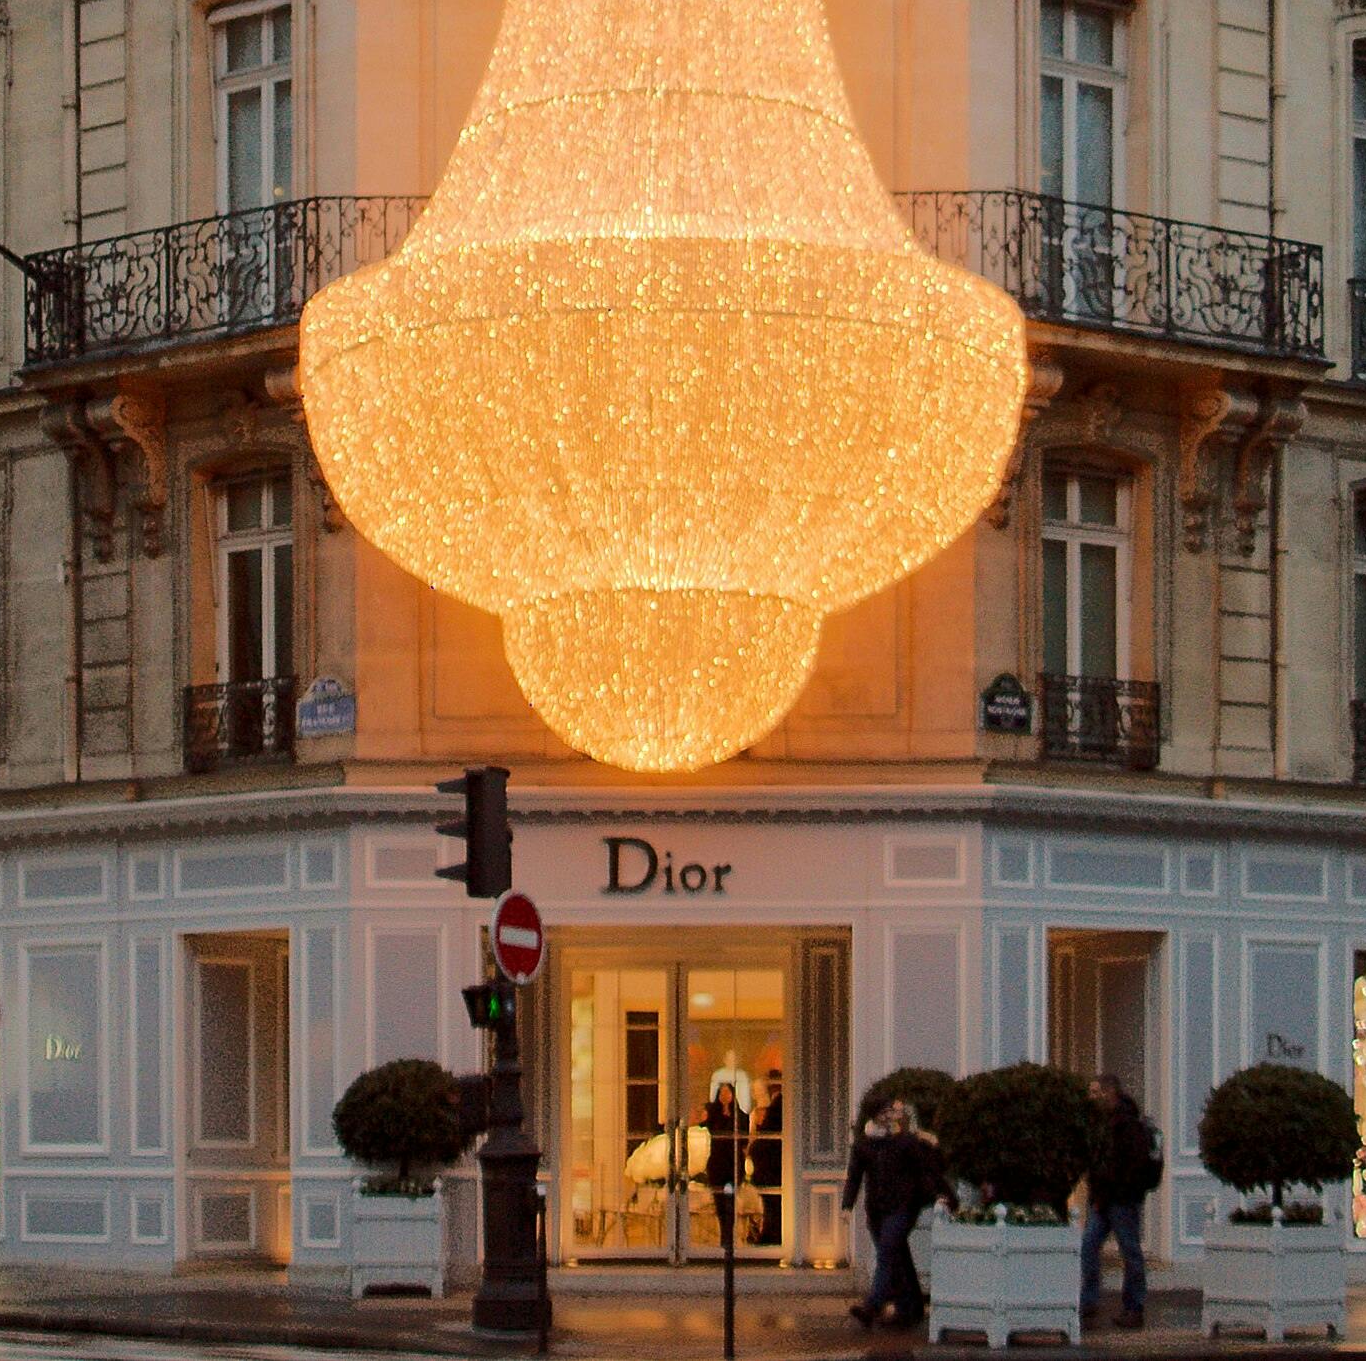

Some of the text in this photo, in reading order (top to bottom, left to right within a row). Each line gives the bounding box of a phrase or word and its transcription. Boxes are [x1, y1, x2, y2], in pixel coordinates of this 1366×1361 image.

[601, 836, 732, 894] Dior
[44, 1035, 82, 1060] Dior
[1266, 1033, 1306, 1057] Dior
